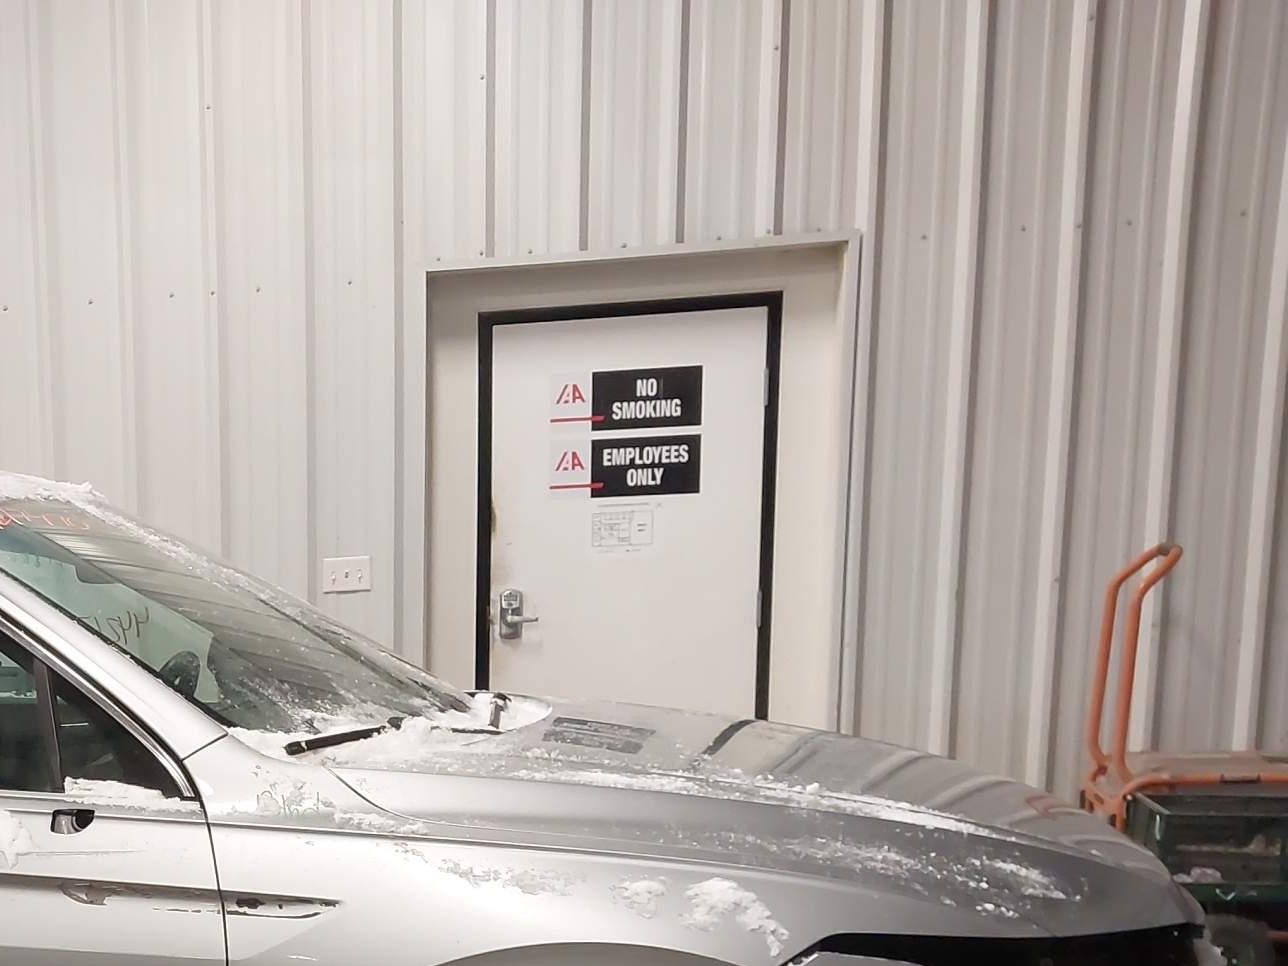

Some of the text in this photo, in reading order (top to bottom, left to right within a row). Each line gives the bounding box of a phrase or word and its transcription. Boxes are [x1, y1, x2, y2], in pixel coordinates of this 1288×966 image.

[636, 378, 657, 397] NO
[611, 398, 681, 421] SMOKING
[603, 444, 689, 466] EMPLOYEES
[626, 467, 664, 487] ONLY
